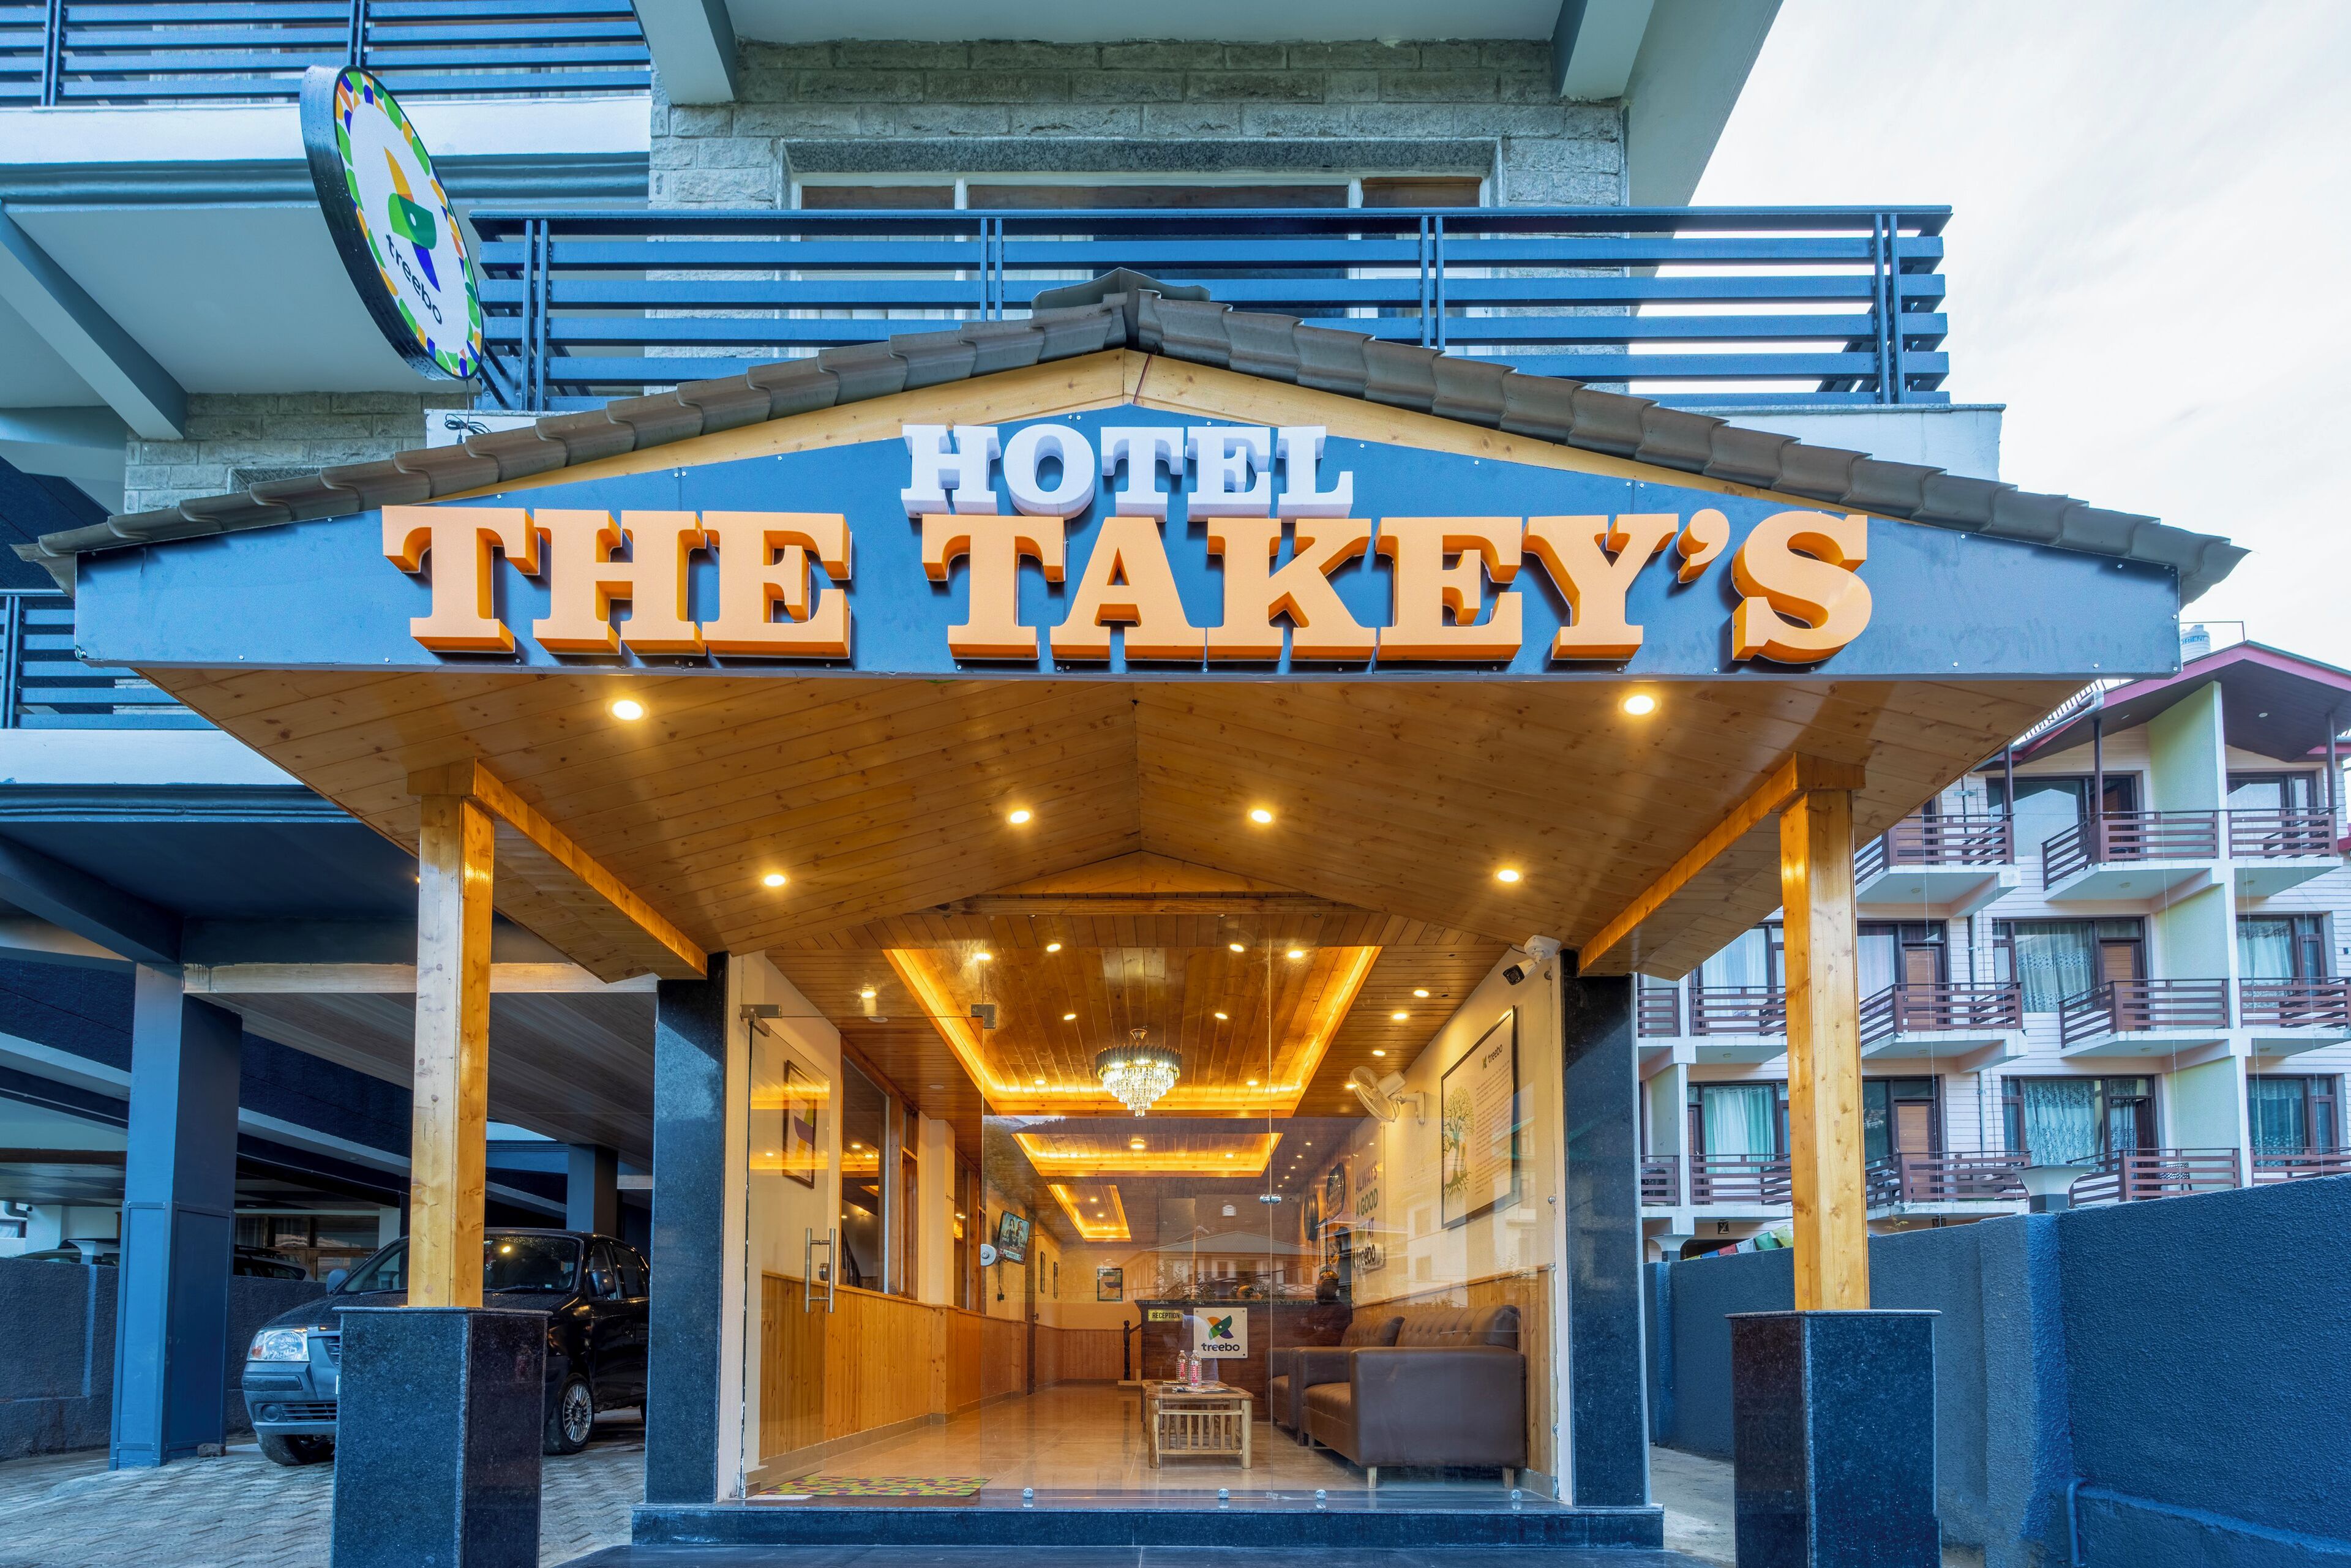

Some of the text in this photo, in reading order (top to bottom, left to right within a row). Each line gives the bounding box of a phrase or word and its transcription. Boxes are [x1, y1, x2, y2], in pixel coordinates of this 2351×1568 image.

[386, 234, 442, 325] treebo
[900, 423, 1354, 523] HOTEL
[382, 505, 1873, 664] THE TAKEY’S
[1488, 1044, 1503, 1063] treebo
[1355, 1160, 1378, 1195] ALWAYS
[1355, 1188, 1378, 1219] A GOOD
[1367, 1217, 1374, 1239] AT
[1356, 1243, 1376, 1269] treebo
[1201, 1343, 1240, 1352] treebo
